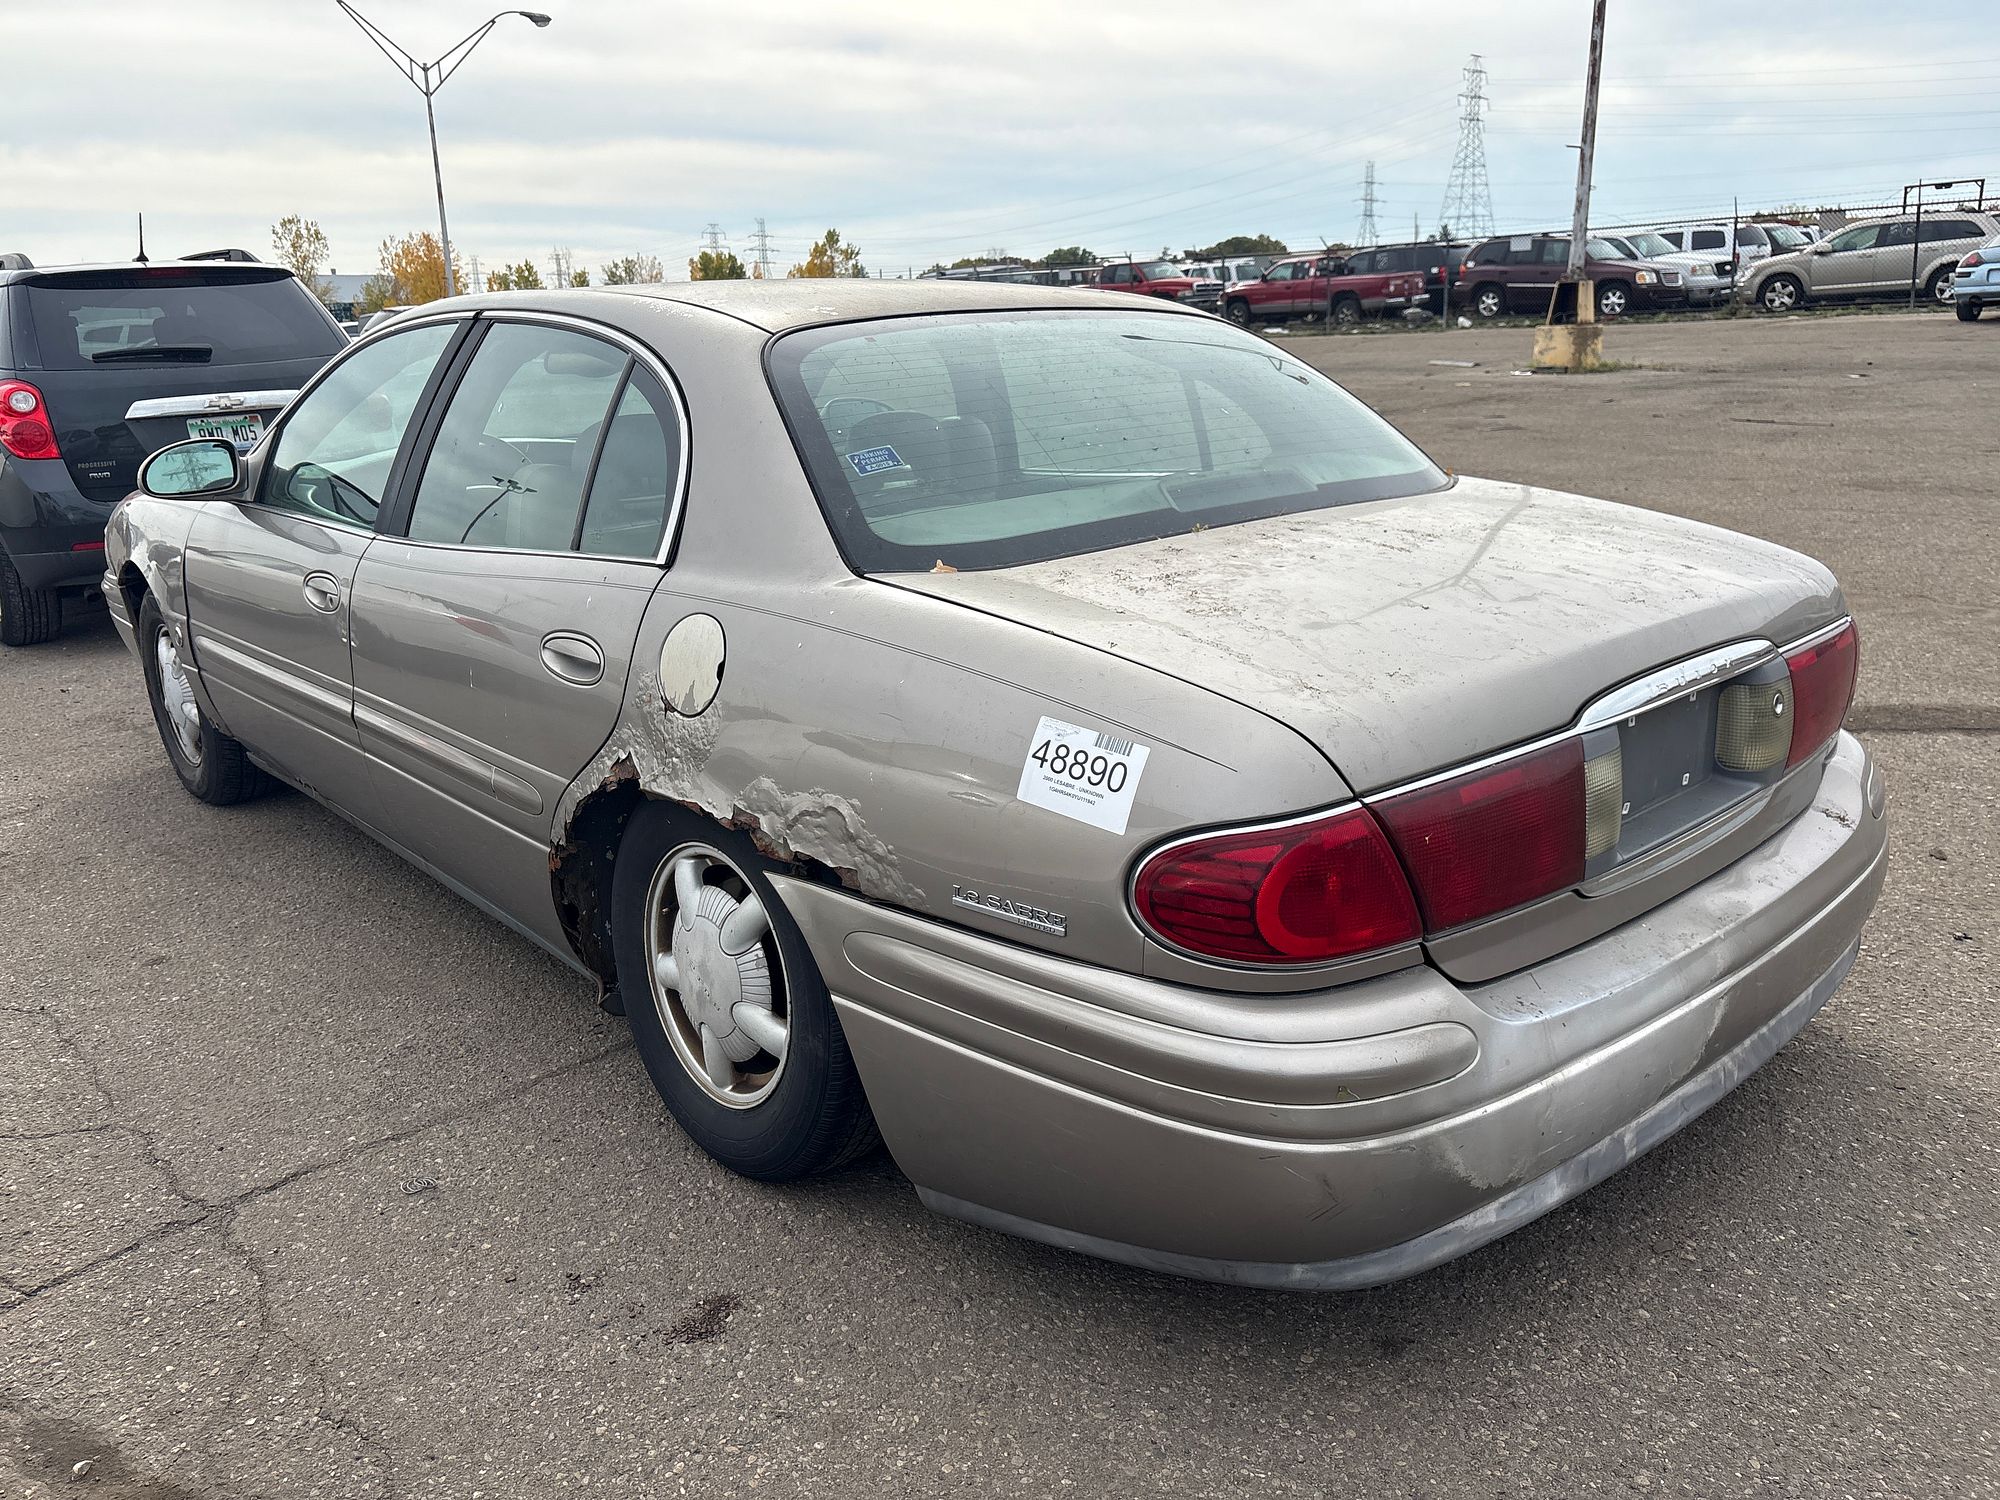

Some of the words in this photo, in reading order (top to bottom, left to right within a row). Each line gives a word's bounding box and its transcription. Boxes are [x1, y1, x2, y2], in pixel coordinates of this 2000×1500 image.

[854, 449, 890, 464] PARKING
[861, 454, 890, 465] PERMIT
[1031, 740, 1128, 793] 48890
[1078, 786, 1105, 800] UNKNOWN
[952, 884, 980, 905] Le
[986, 894, 1067, 928] SABRE
